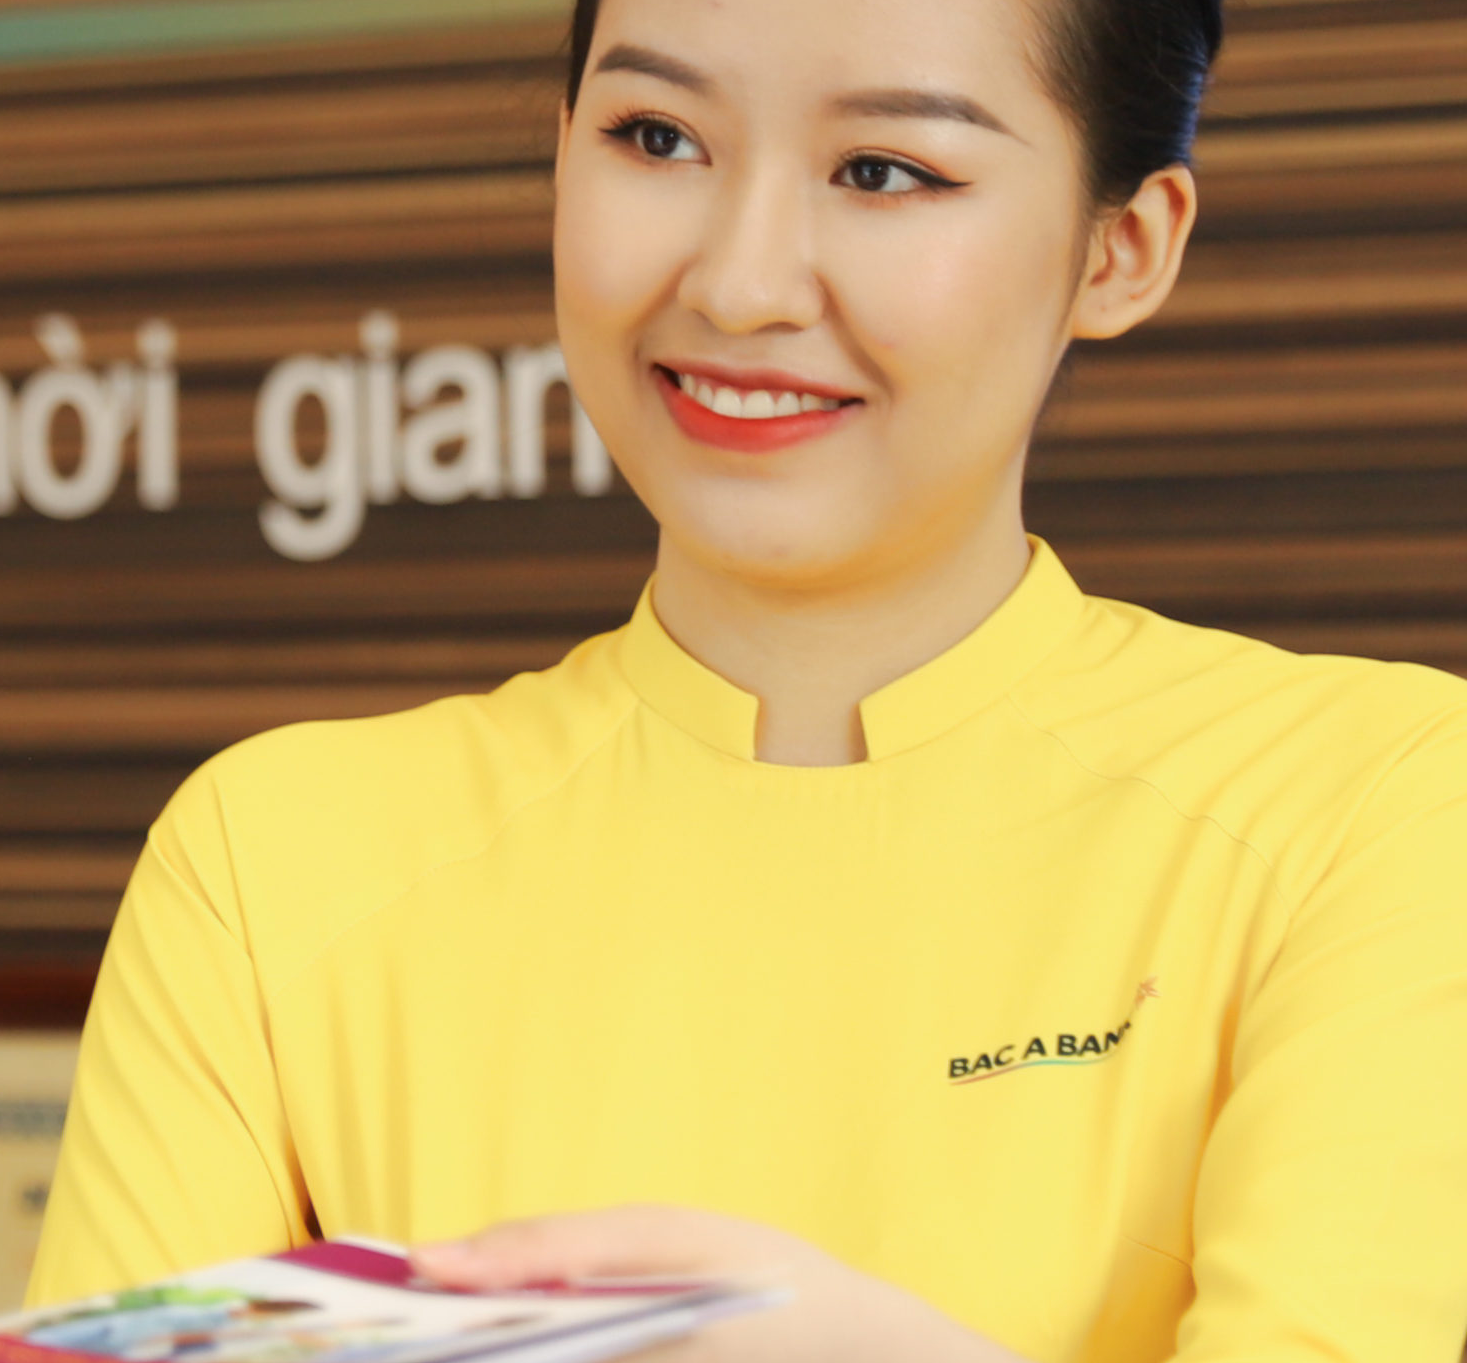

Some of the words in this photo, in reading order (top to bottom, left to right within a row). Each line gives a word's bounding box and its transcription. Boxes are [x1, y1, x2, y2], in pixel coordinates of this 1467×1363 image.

[255, 314, 611, 561] gian
[947, 1044, 1016, 1079] BAC
[1021, 1036, 1048, 1060] A
